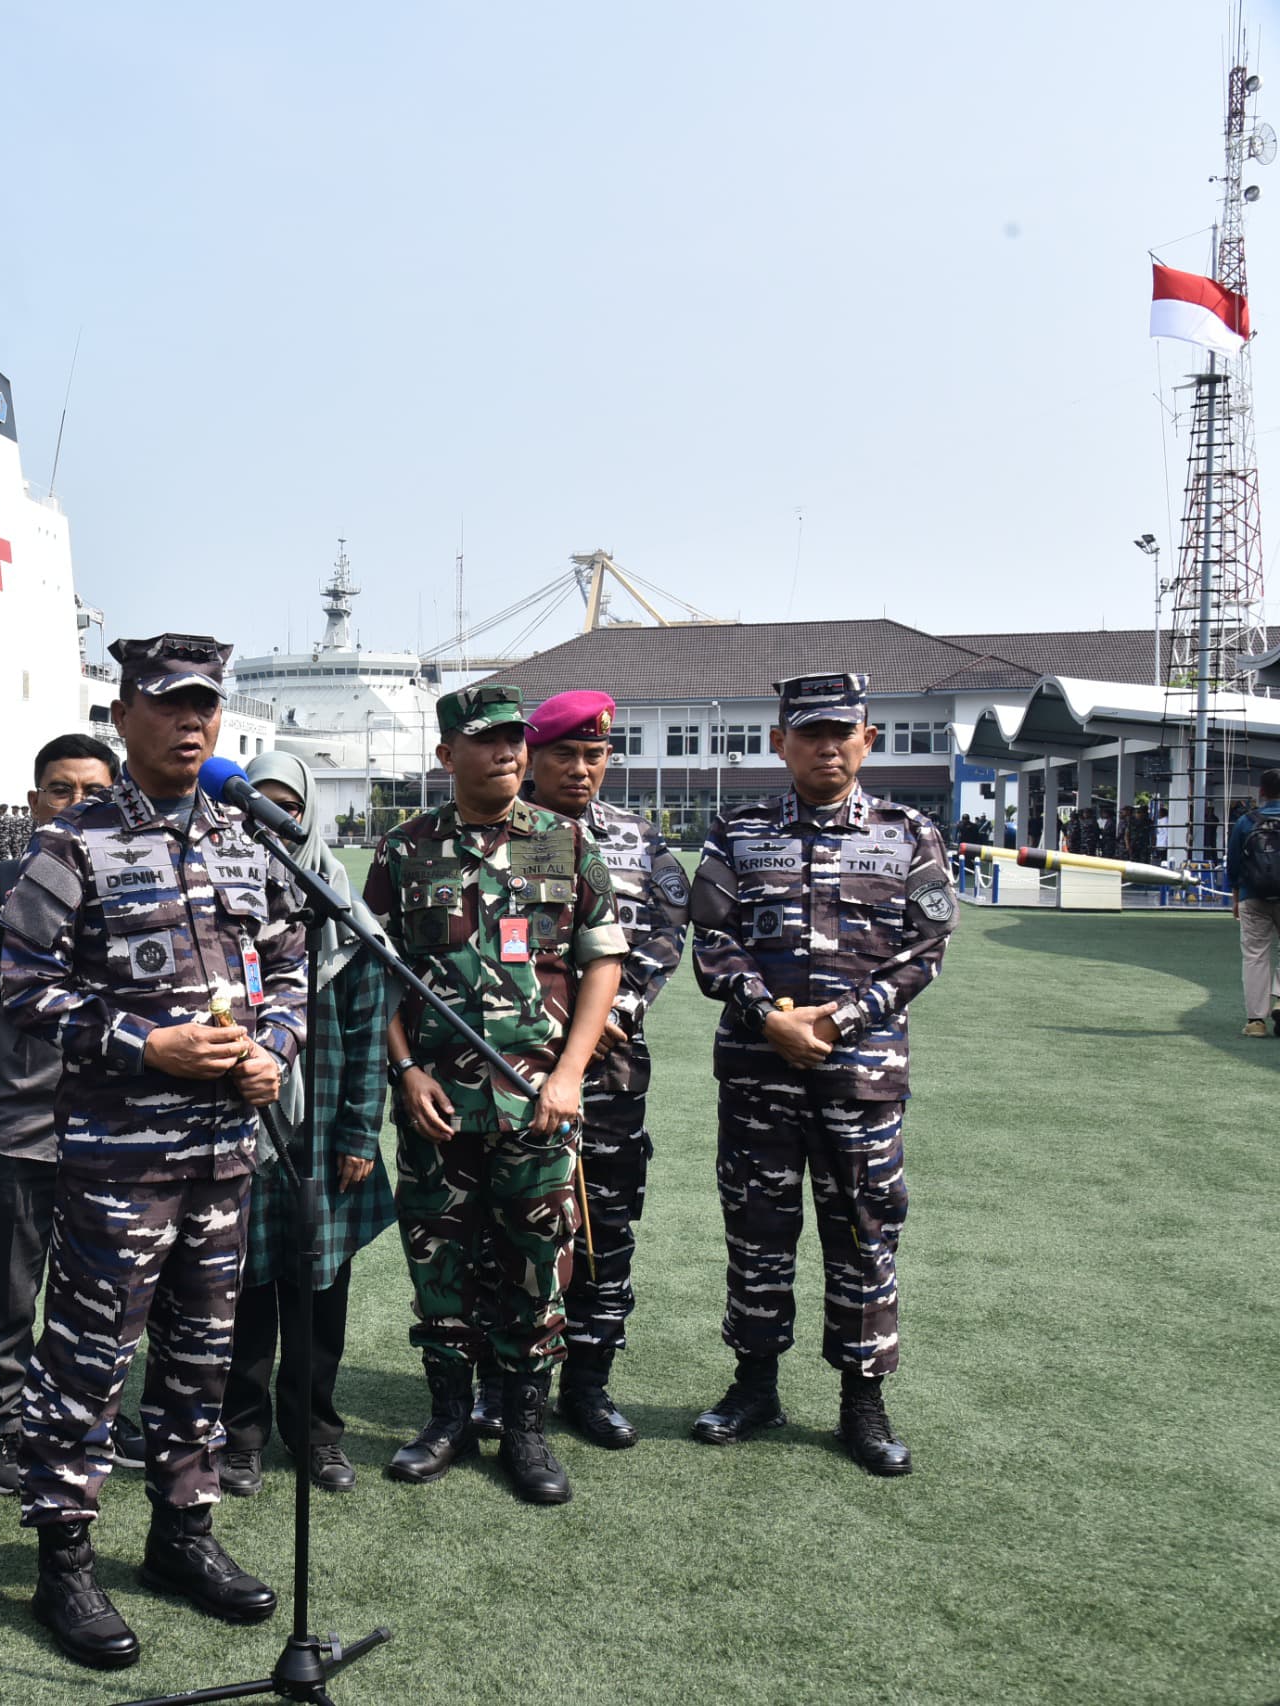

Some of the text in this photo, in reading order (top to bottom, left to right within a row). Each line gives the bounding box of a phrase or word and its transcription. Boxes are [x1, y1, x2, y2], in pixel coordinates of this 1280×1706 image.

[546, 864, 564, 873] AU
[628, 858, 646, 868] AL
[739, 857, 796, 870] KRISNO
[847, 860, 903, 875] TNI AL
[106, 870, 164, 888] DENIH
[215, 866, 262, 882] TNI AL
